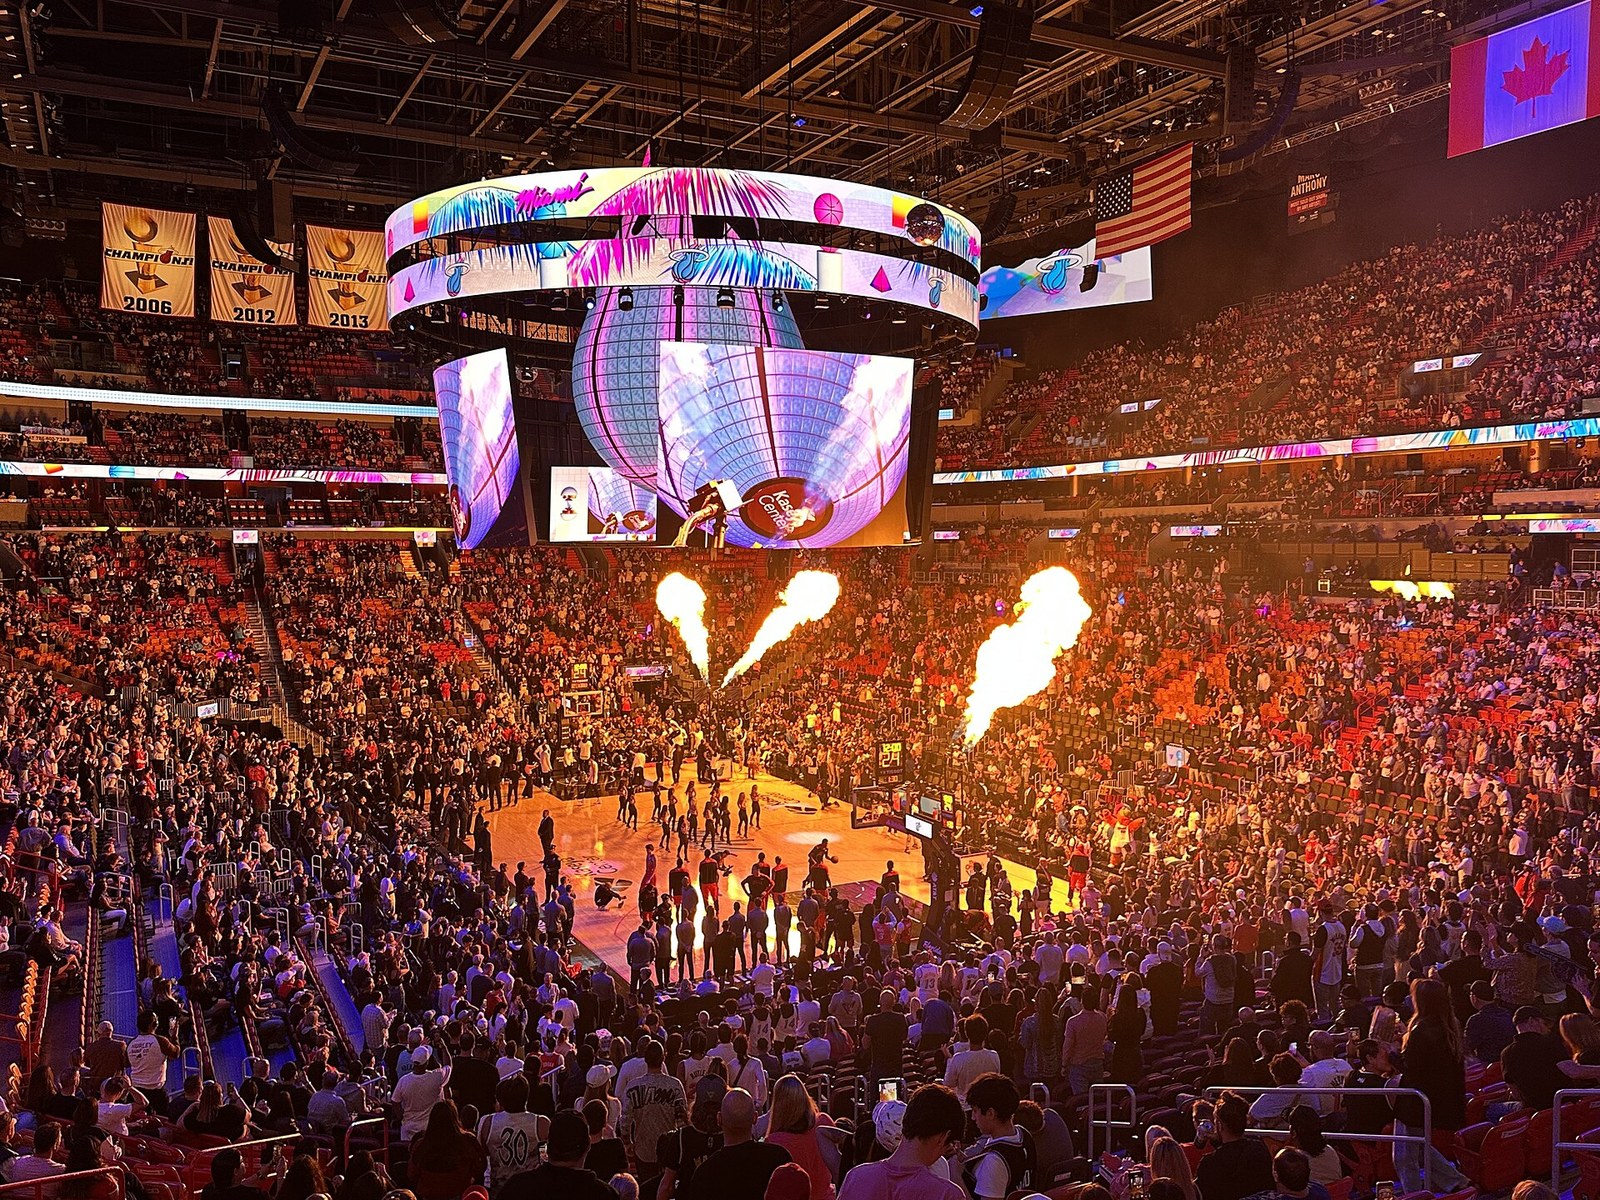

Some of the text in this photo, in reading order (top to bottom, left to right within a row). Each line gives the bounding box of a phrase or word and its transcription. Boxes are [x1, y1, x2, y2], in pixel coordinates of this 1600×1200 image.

[1290, 175, 1328, 198] ANTHONY
[123, 296, 172, 315] 2006
[233, 307, 275, 324] 2012
[329, 312, 369, 328] 2013
[758, 494, 787, 529] Cente
[881, 752, 900, 768] 24
[925, 979, 935, 989] 13
[757, 1024, 769, 1034] 14
[496, 1127, 529, 1167] 30
